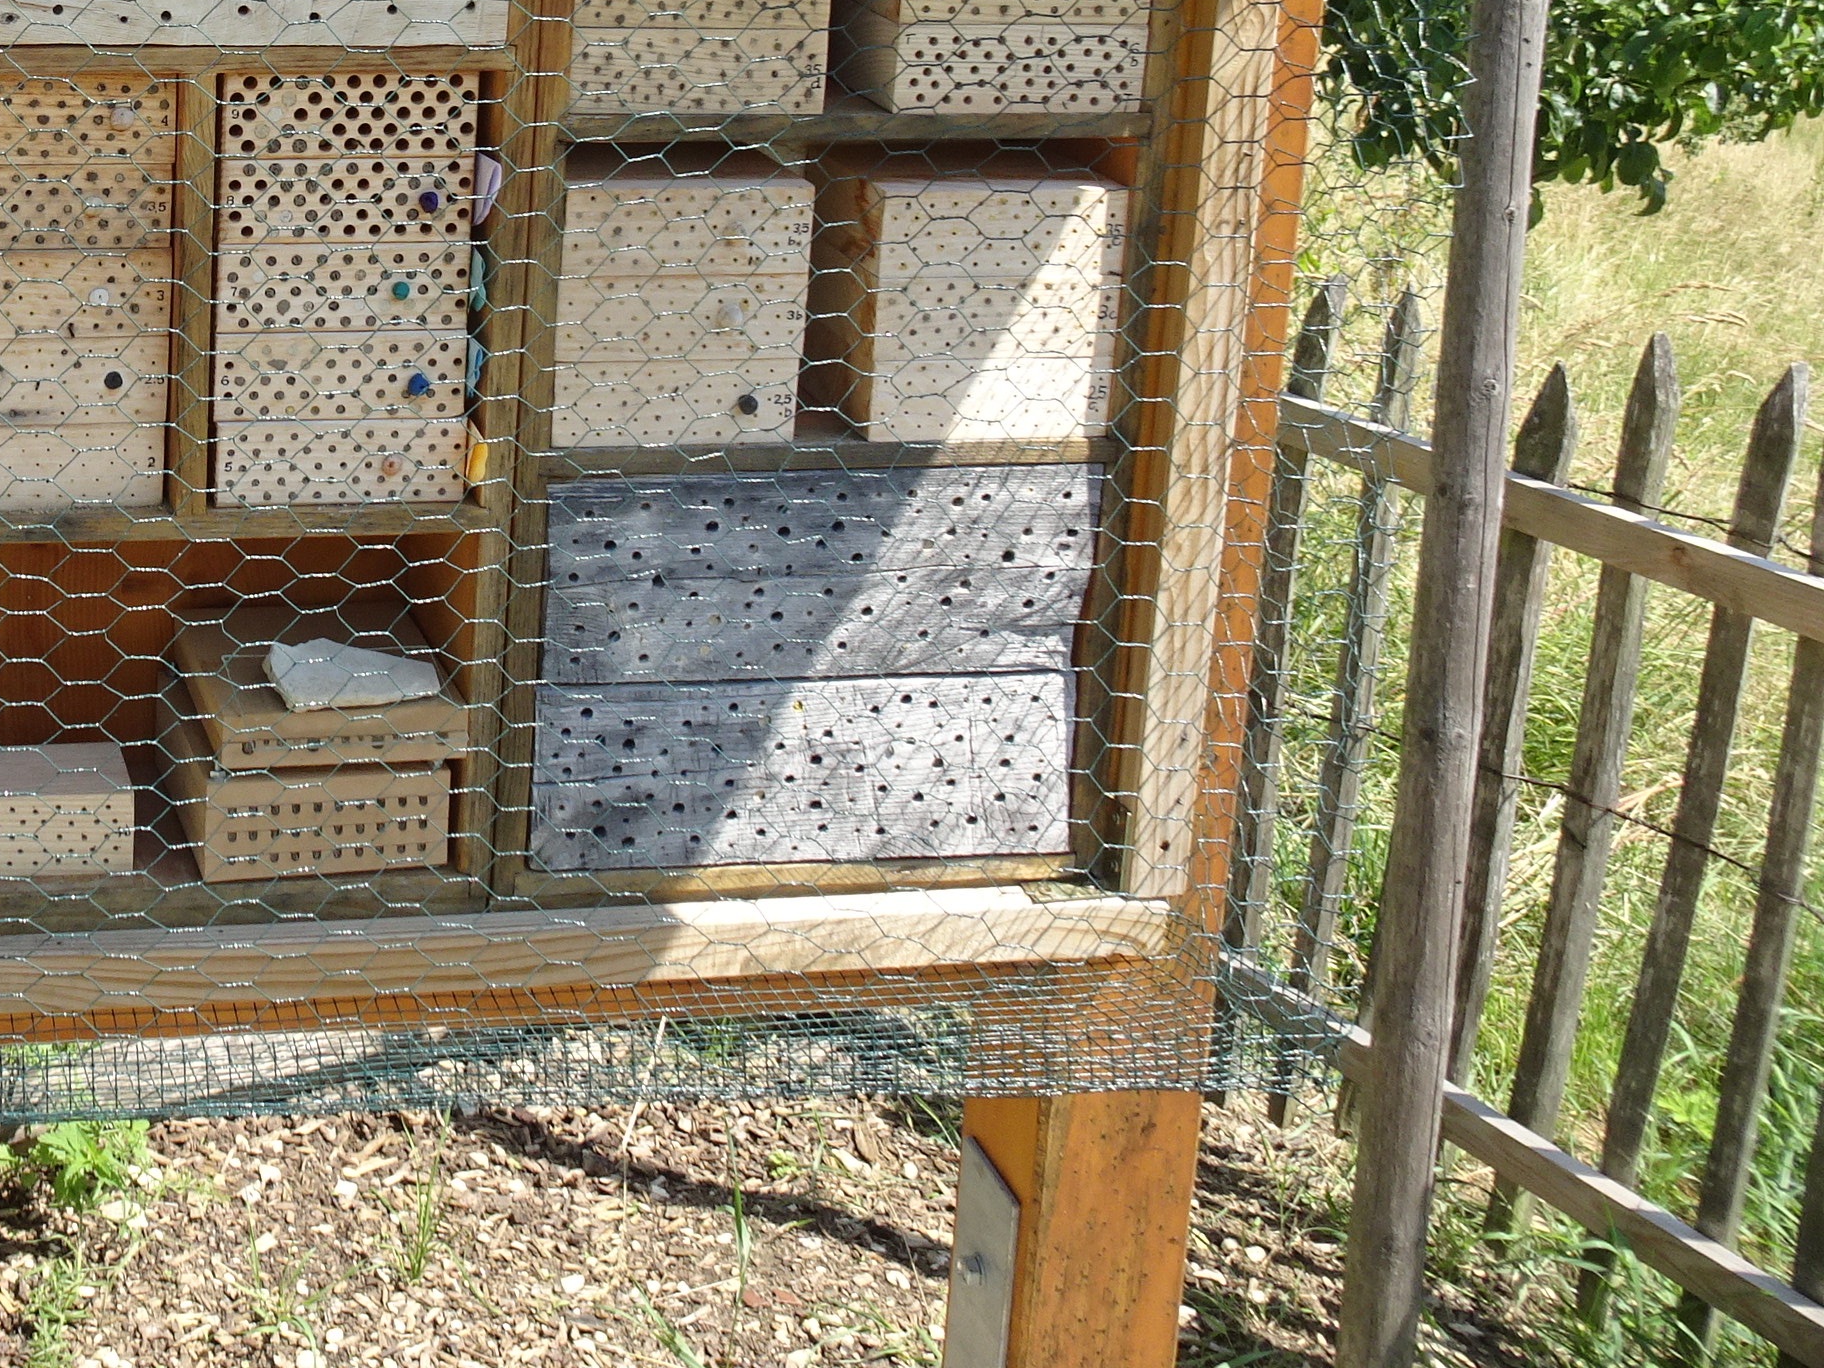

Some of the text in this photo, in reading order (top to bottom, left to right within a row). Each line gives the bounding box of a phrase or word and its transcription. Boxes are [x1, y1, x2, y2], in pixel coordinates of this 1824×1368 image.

[231, 109, 239, 120] 9
[161, 115, 169, 126] 4
[226, 196, 235, 206] 8
[148, 202, 166, 213] 3,5
[793, 225, 810, 235] 3,5
[787, 237, 796, 246] b
[157, 290, 165, 301] 3
[231, 287, 238, 297] 7
[787, 310, 803, 320] 3b
[1098, 305, 1117, 320] 3c
[221, 376, 230, 386] 6
[773, 394, 792, 405] 2,5
[784, 407, 792, 418] b
[148, 457, 156, 467] 2
[224, 462, 233, 472] 5
